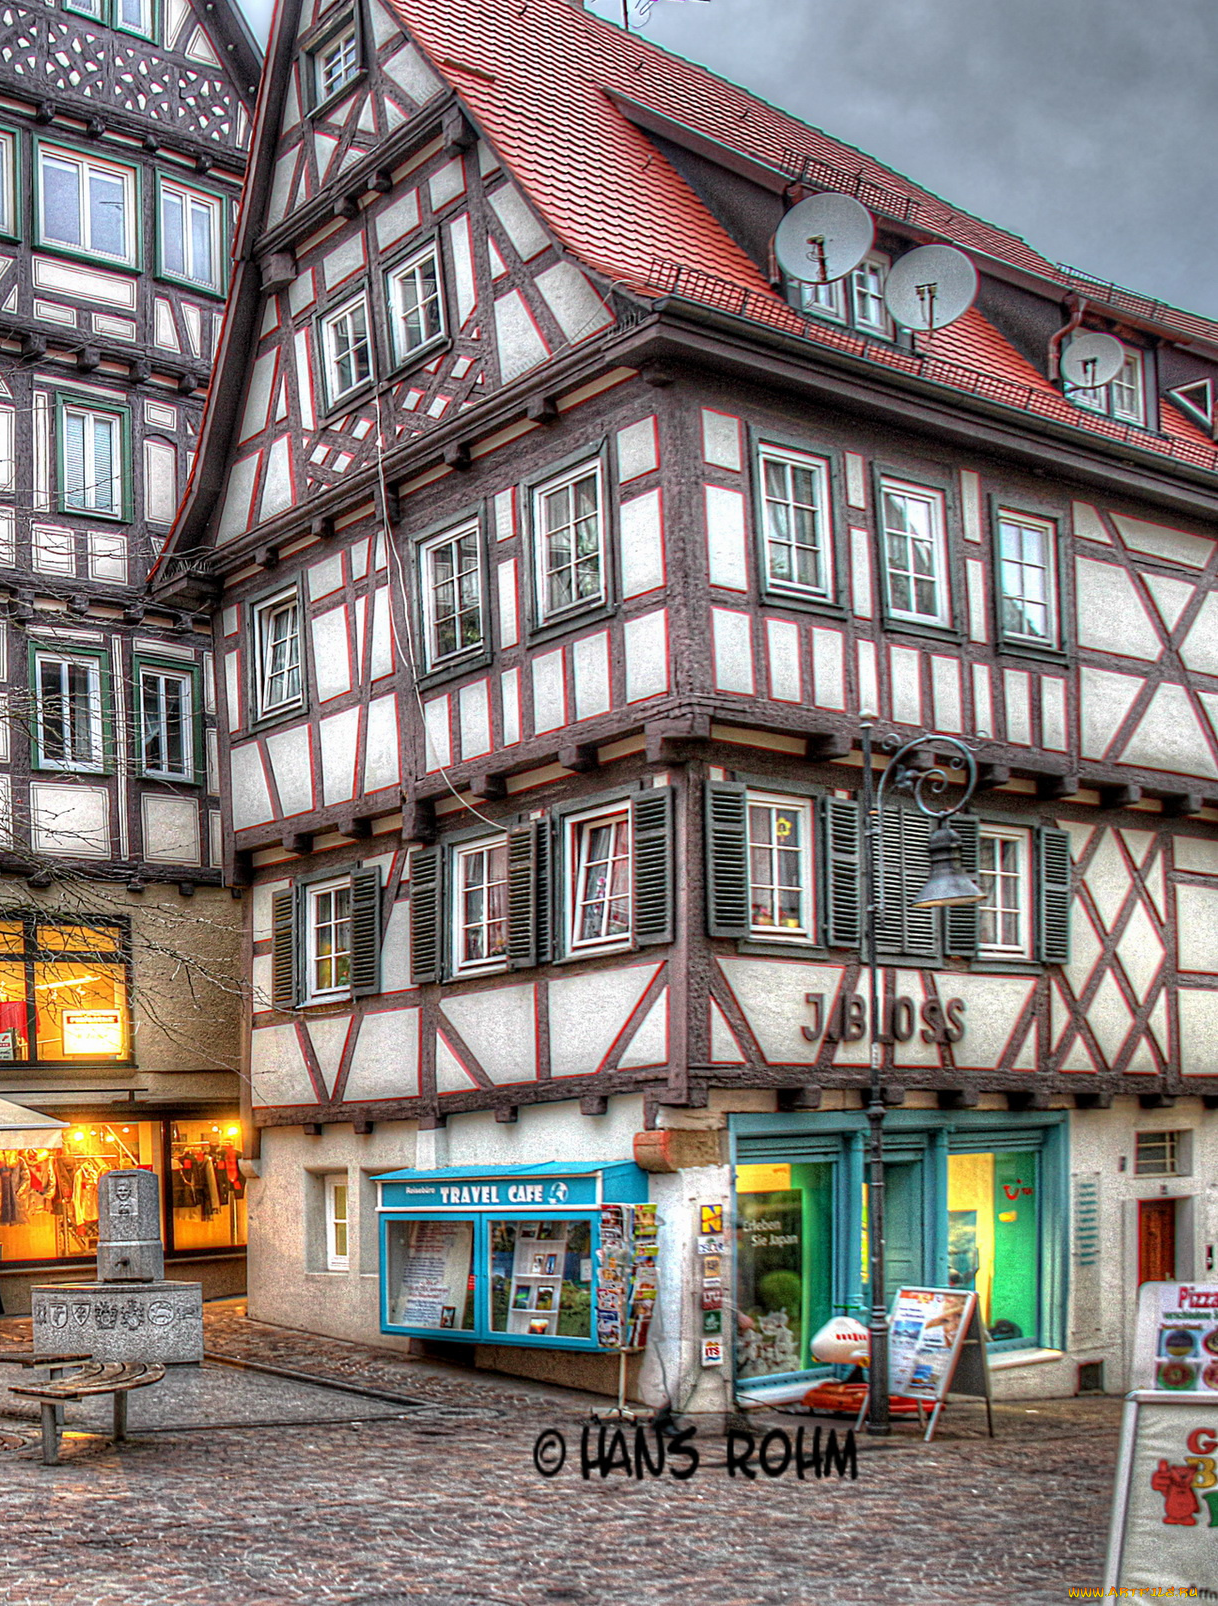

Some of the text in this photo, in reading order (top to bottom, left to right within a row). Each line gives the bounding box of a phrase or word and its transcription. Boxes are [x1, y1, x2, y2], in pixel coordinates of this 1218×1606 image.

[440, 1186, 500, 1204] TRAVEL
[508, 1184, 544, 1203] CAFE
[742, 1218, 782, 1233] Erleben
[751, 1234, 799, 1248] Sie Japan
[705, 1346, 721, 1357] ITS
